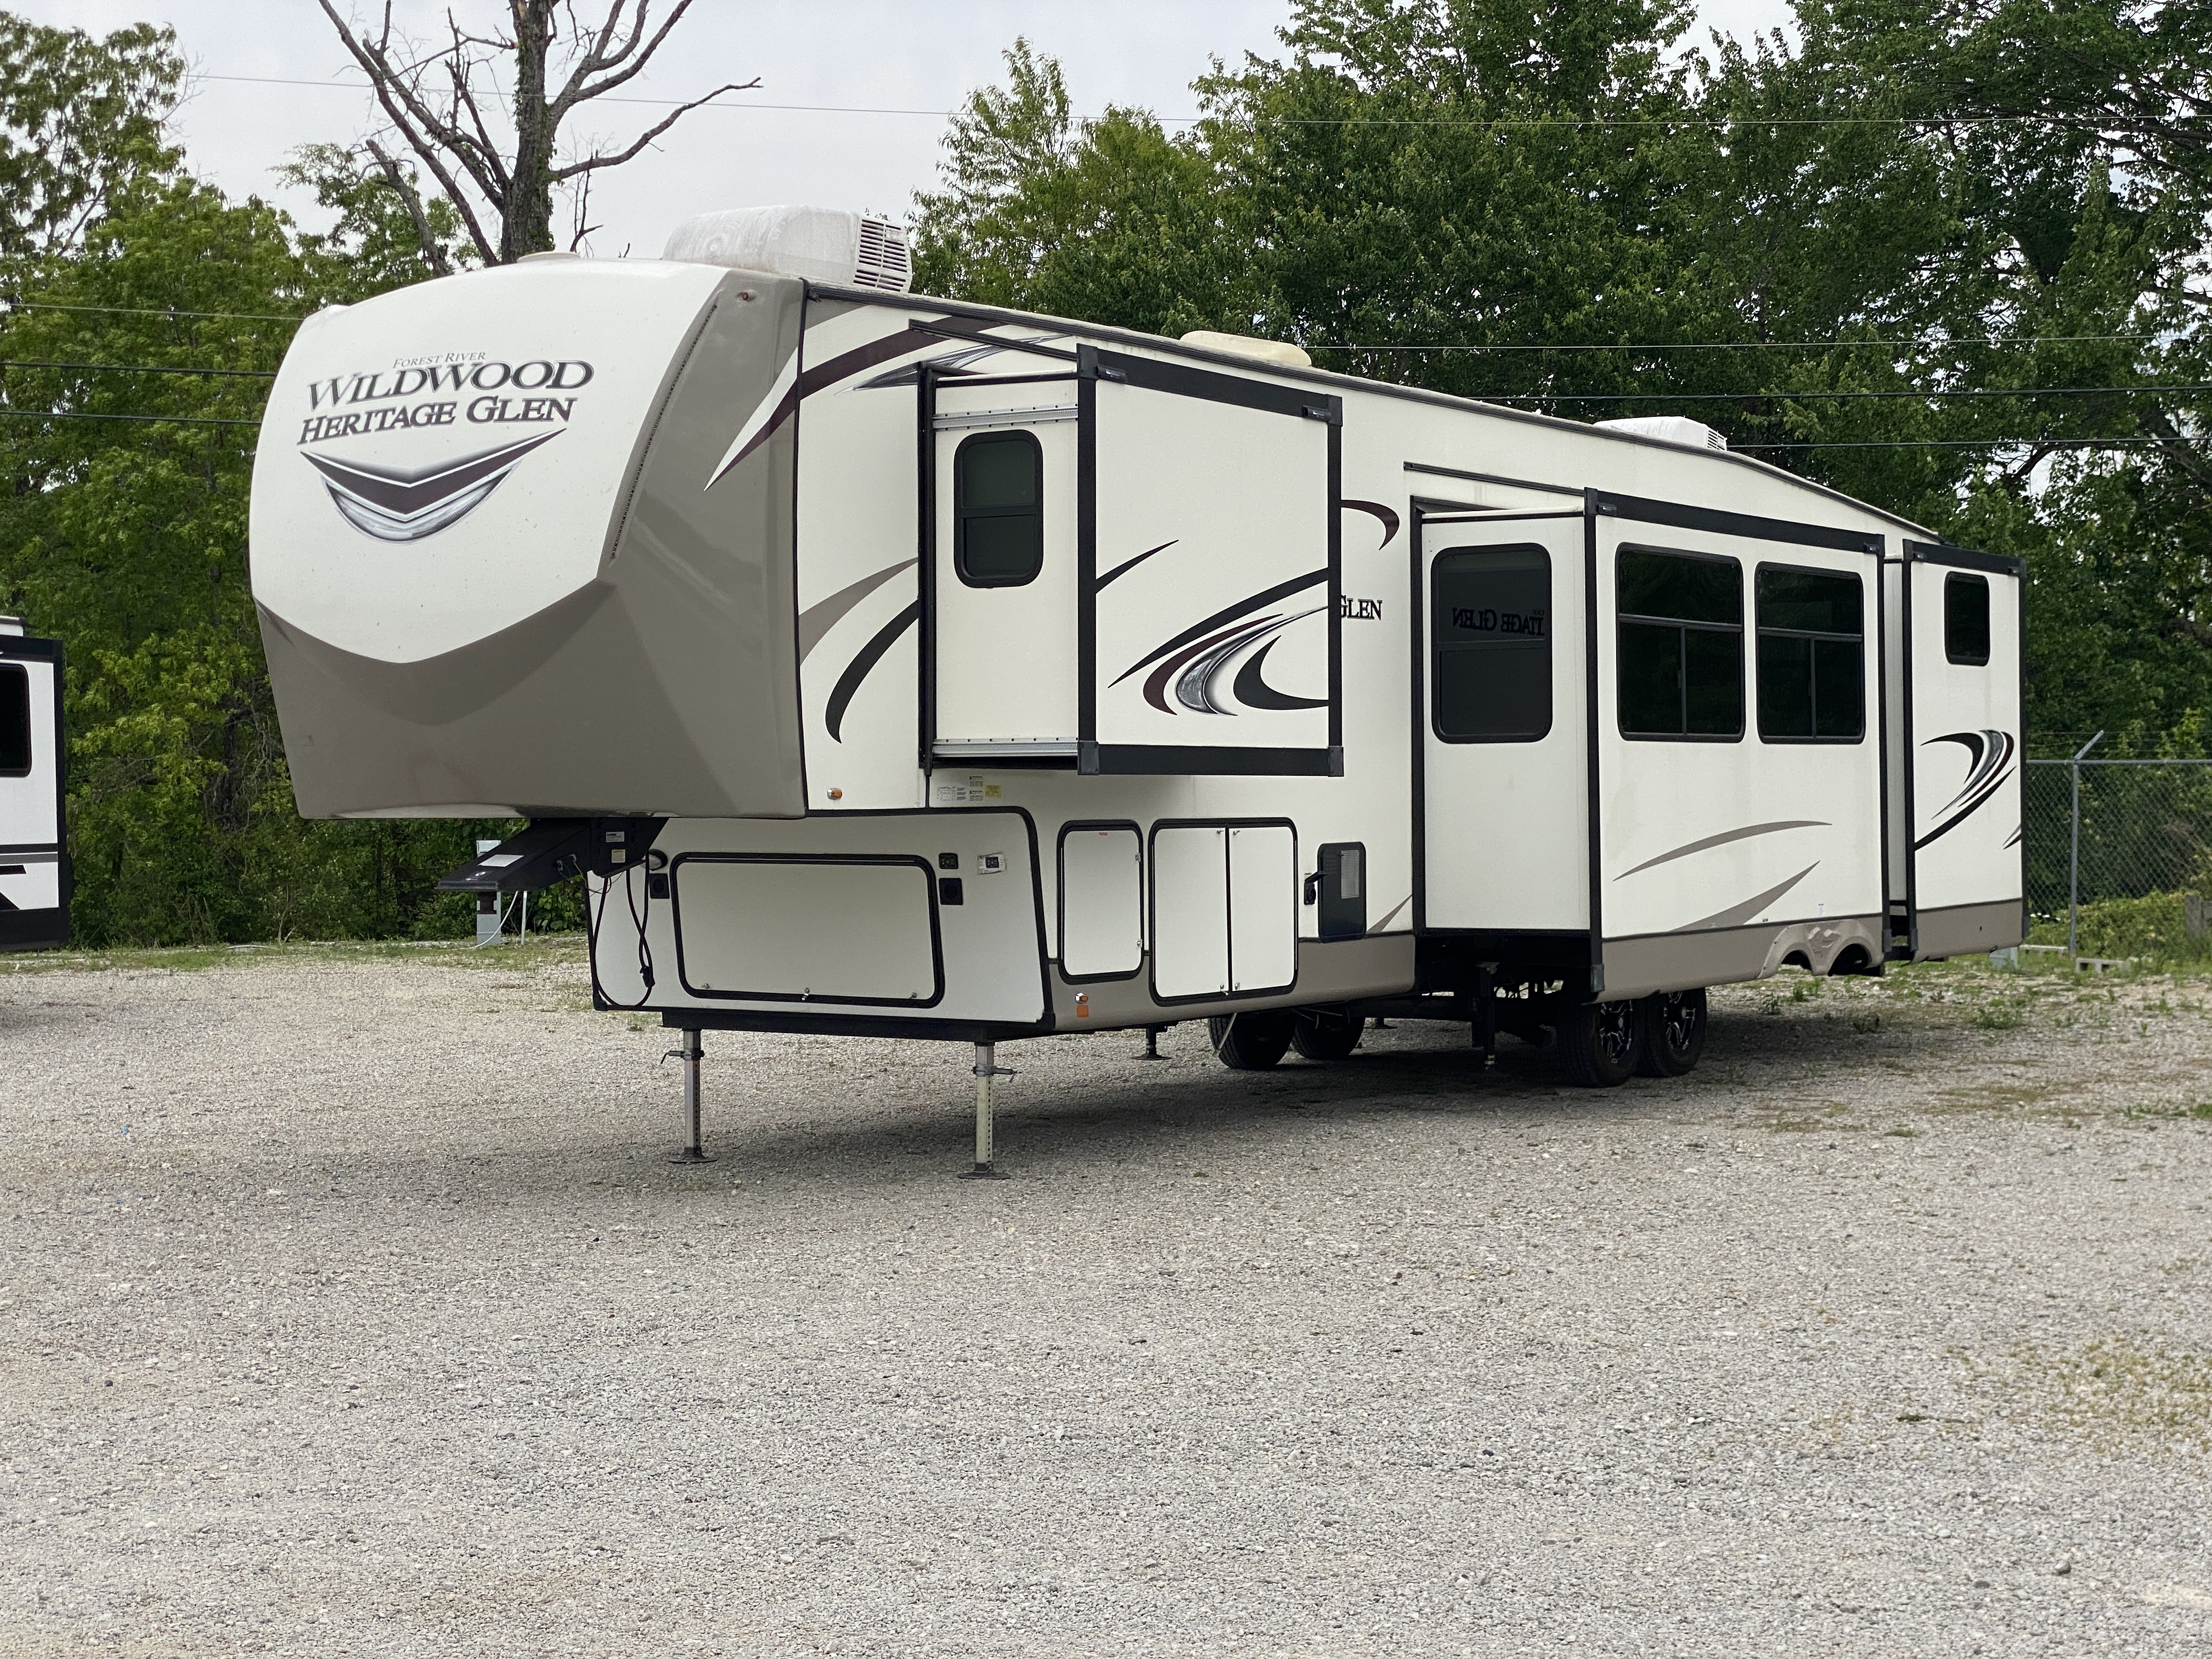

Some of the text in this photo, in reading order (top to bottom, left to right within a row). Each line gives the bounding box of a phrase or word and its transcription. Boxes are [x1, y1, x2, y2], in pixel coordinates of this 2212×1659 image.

[393, 352, 486, 368] FOREST RIVER
[307, 360, 594, 411] WILDWOOD
[296, 396, 578, 445] HERITAGE GLEN
